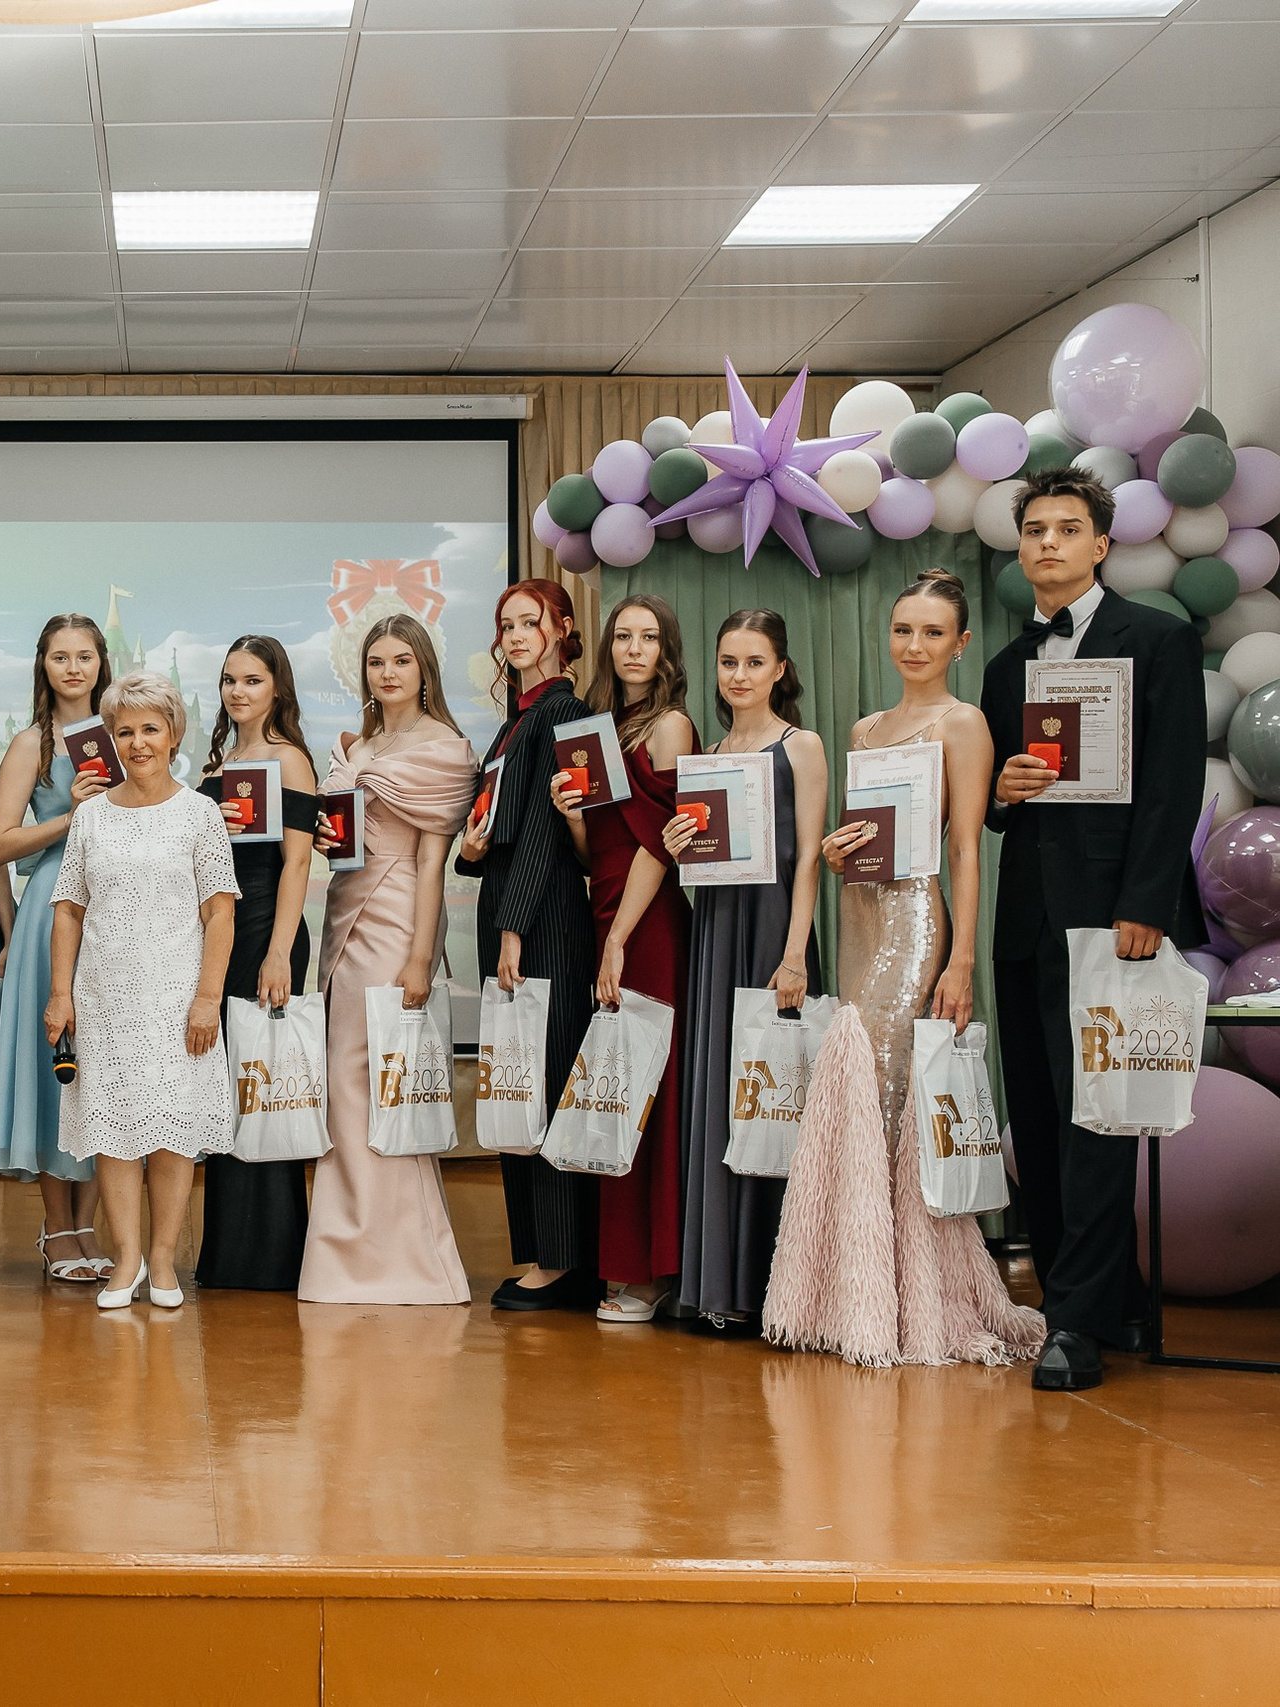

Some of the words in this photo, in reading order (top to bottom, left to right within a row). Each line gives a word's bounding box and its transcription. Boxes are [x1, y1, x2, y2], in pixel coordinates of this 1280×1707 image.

[854, 857, 884, 865] АТТЕСТАТ
[1129, 1029, 1194, 1057] 2026
[272, 1075, 323, 1099] 2026
[412, 1069, 447, 1091] 202
[492, 1065, 533, 1089] 2026
[734, 1079, 803, 1123] ВЫПУС
[778, 1083, 806, 1109] 20
